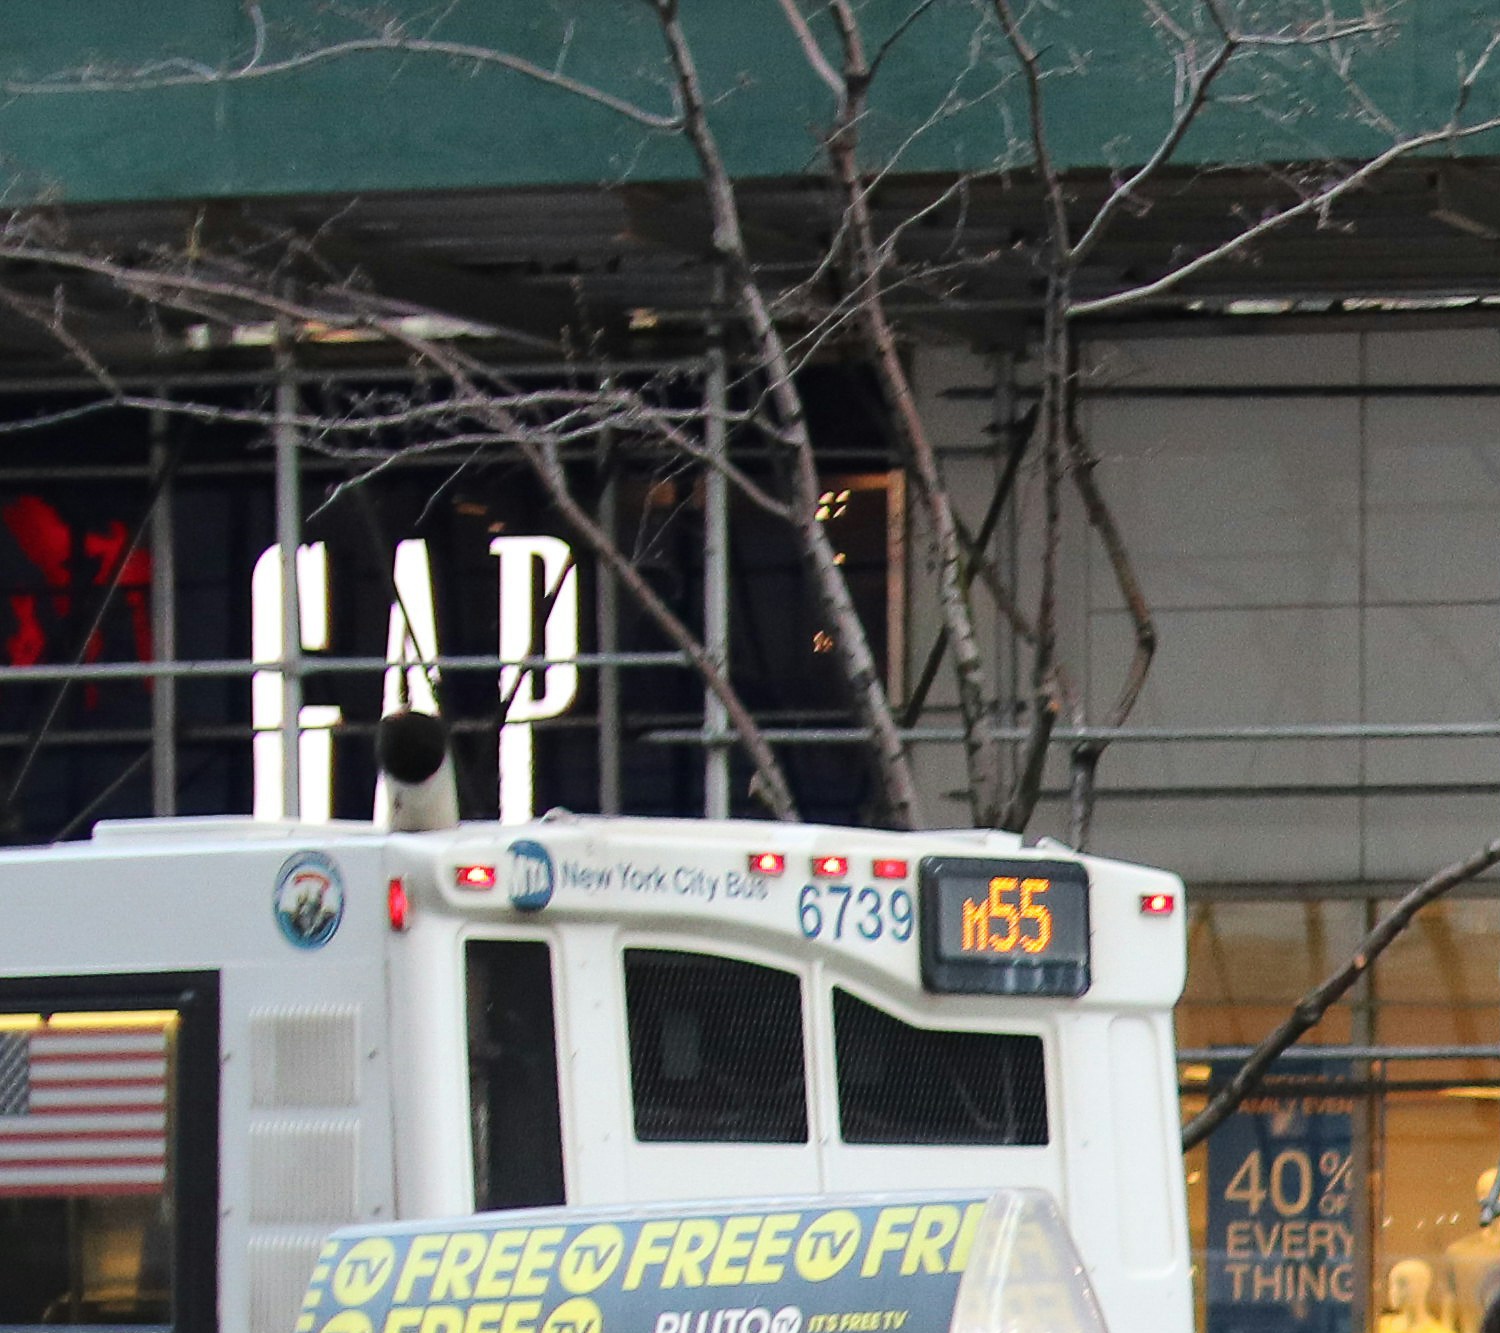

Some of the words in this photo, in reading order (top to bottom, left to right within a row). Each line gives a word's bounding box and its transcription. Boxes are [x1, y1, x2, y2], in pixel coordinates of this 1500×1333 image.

[251, 534, 578, 826] GAP
[561, 857, 612, 890] New
[615, 860, 668, 893] York
[673, 865, 720, 902] City
[725, 869, 769, 901] Bus
[799, 884, 915, 943] 6739
[392, 1227, 567, 1302] FREE
[622, 1212, 802, 1292] FREE
[1226, 1220, 1354, 1260] EVERY
[1225, 1263, 1354, 1303] THING
